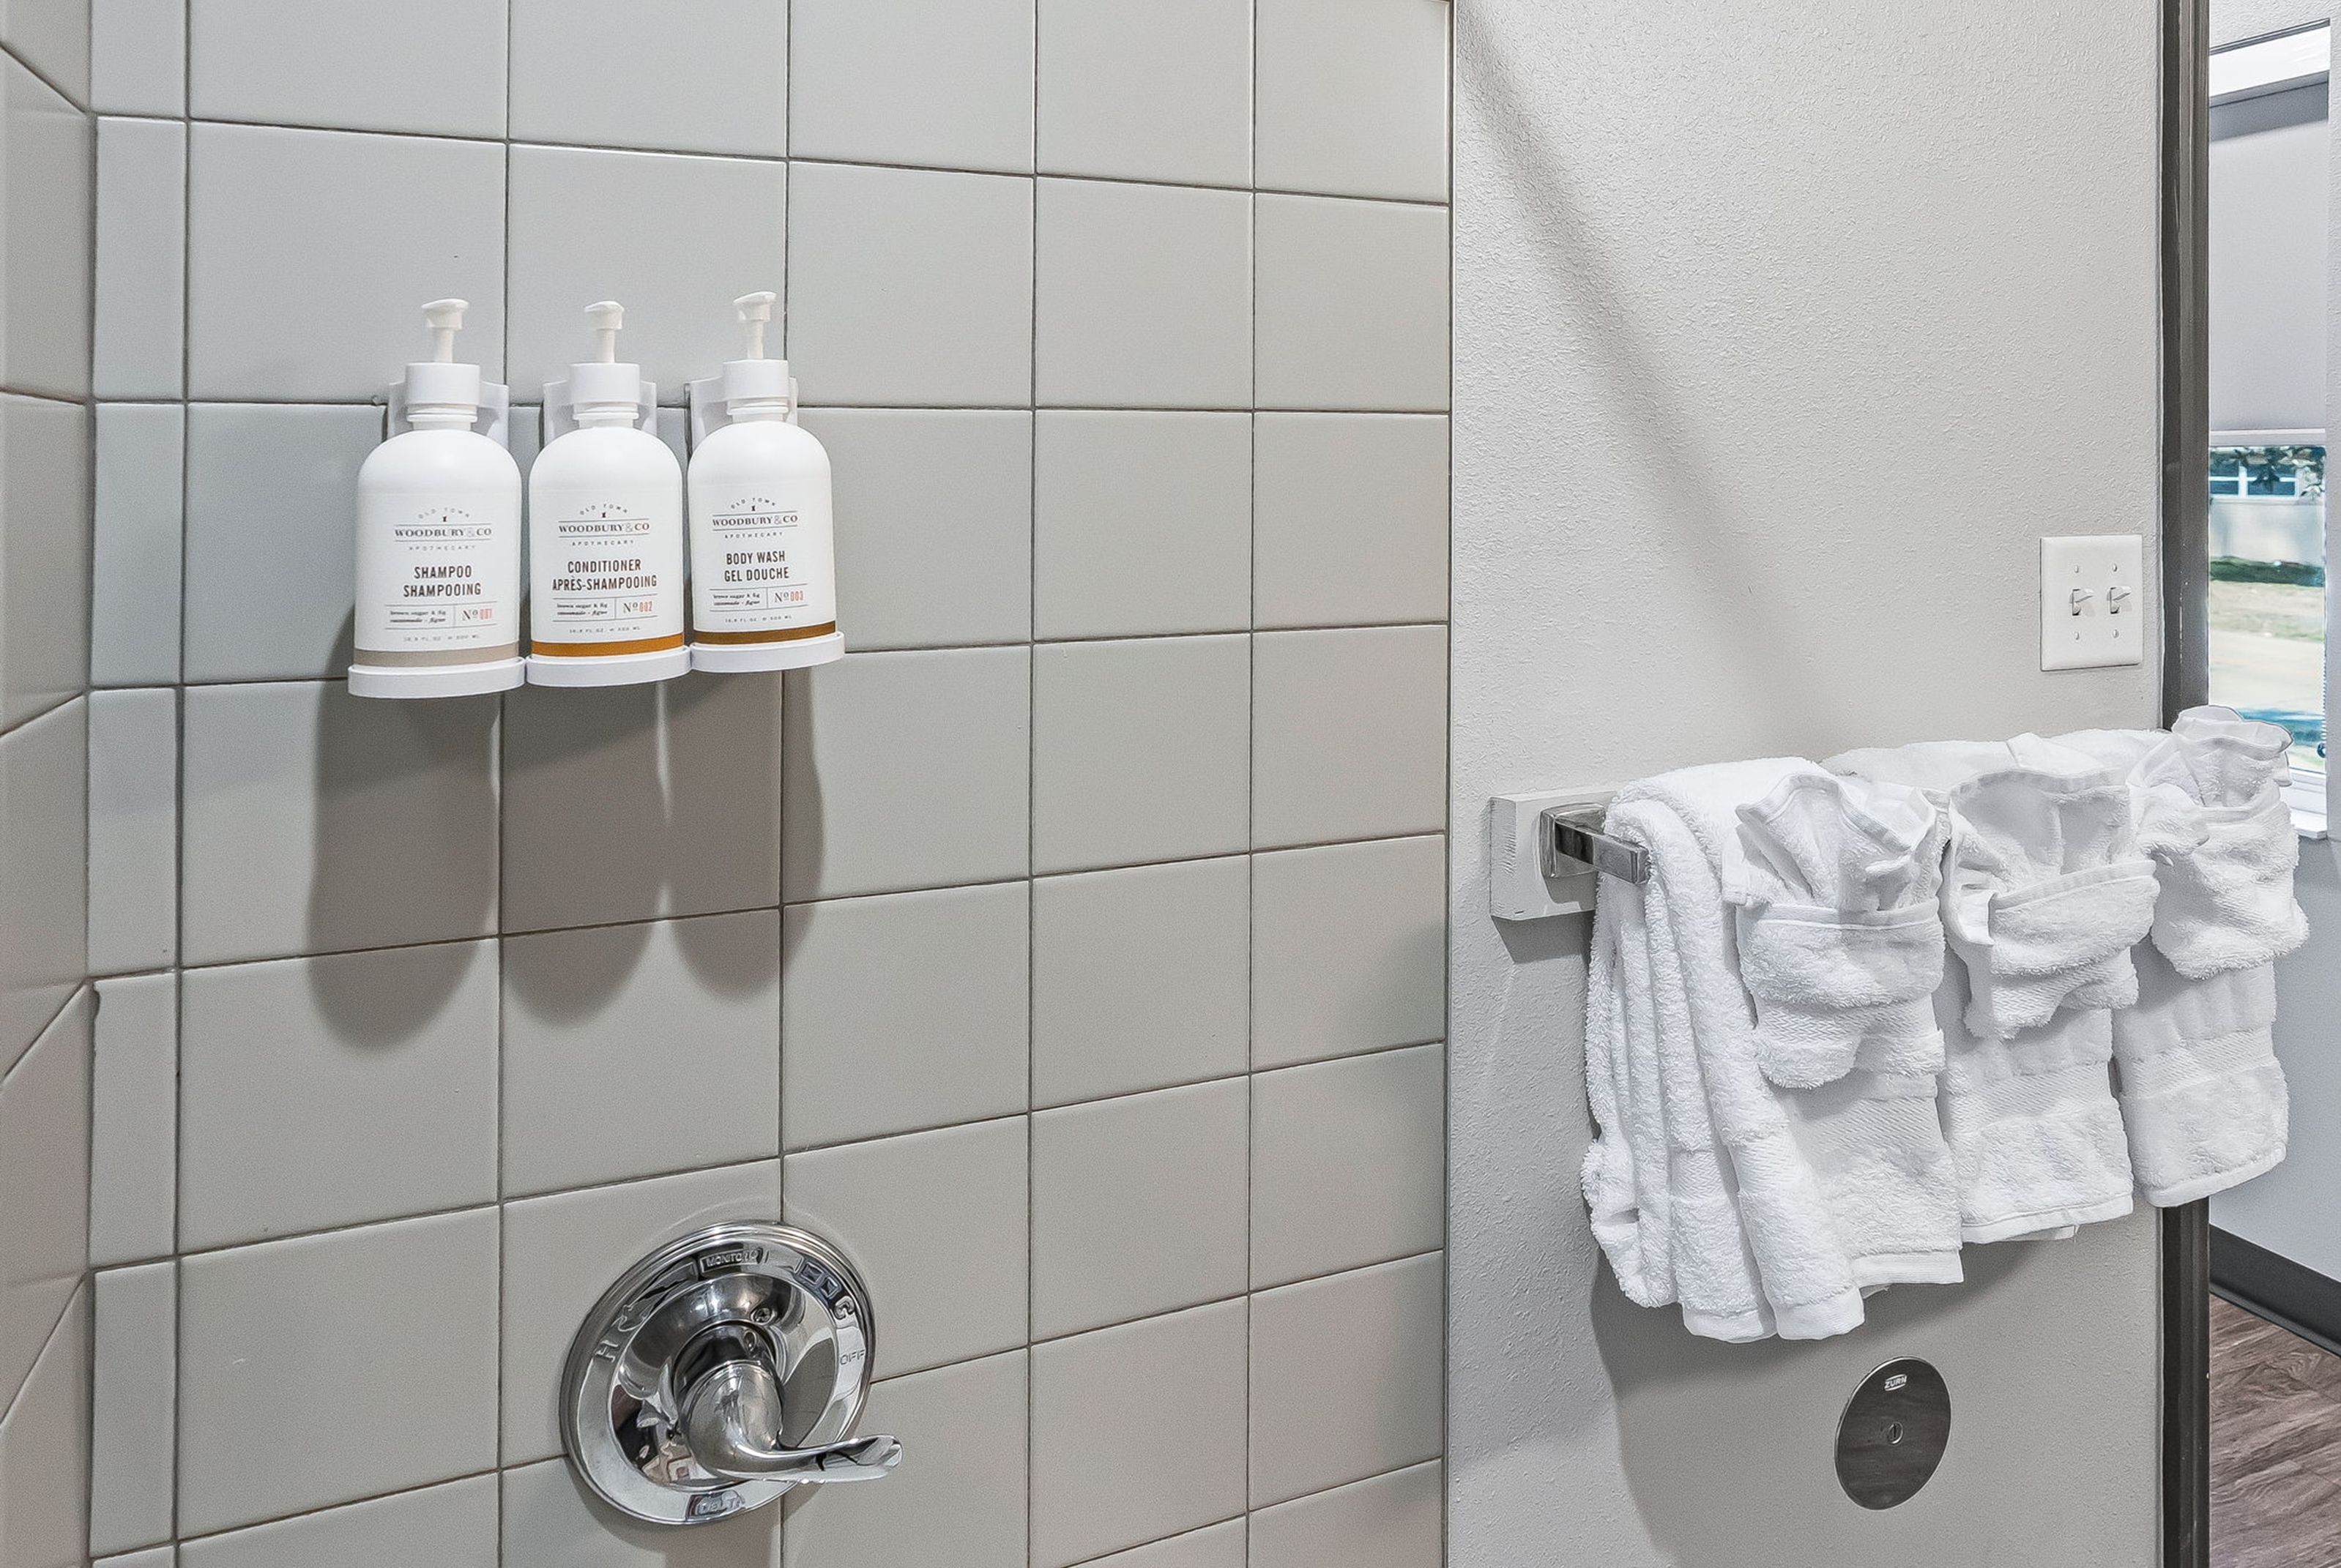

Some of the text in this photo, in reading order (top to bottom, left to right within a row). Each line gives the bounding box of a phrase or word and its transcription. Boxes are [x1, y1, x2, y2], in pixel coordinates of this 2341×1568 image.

[726, 550, 786, 565] BODY WASH
[414, 565, 472, 579] SHAMPOO
[567, 559, 641, 574] CONDITIONER
[724, 567, 790, 582] GEL DOUCHE
[403, 583, 482, 597] SHAMPOOING
[552, 575, 657, 591] APRÈS-SHAMPOOING
[839, 1349, 866, 1365] OFF
[1883, 1375, 1908, 1389] ZURN
